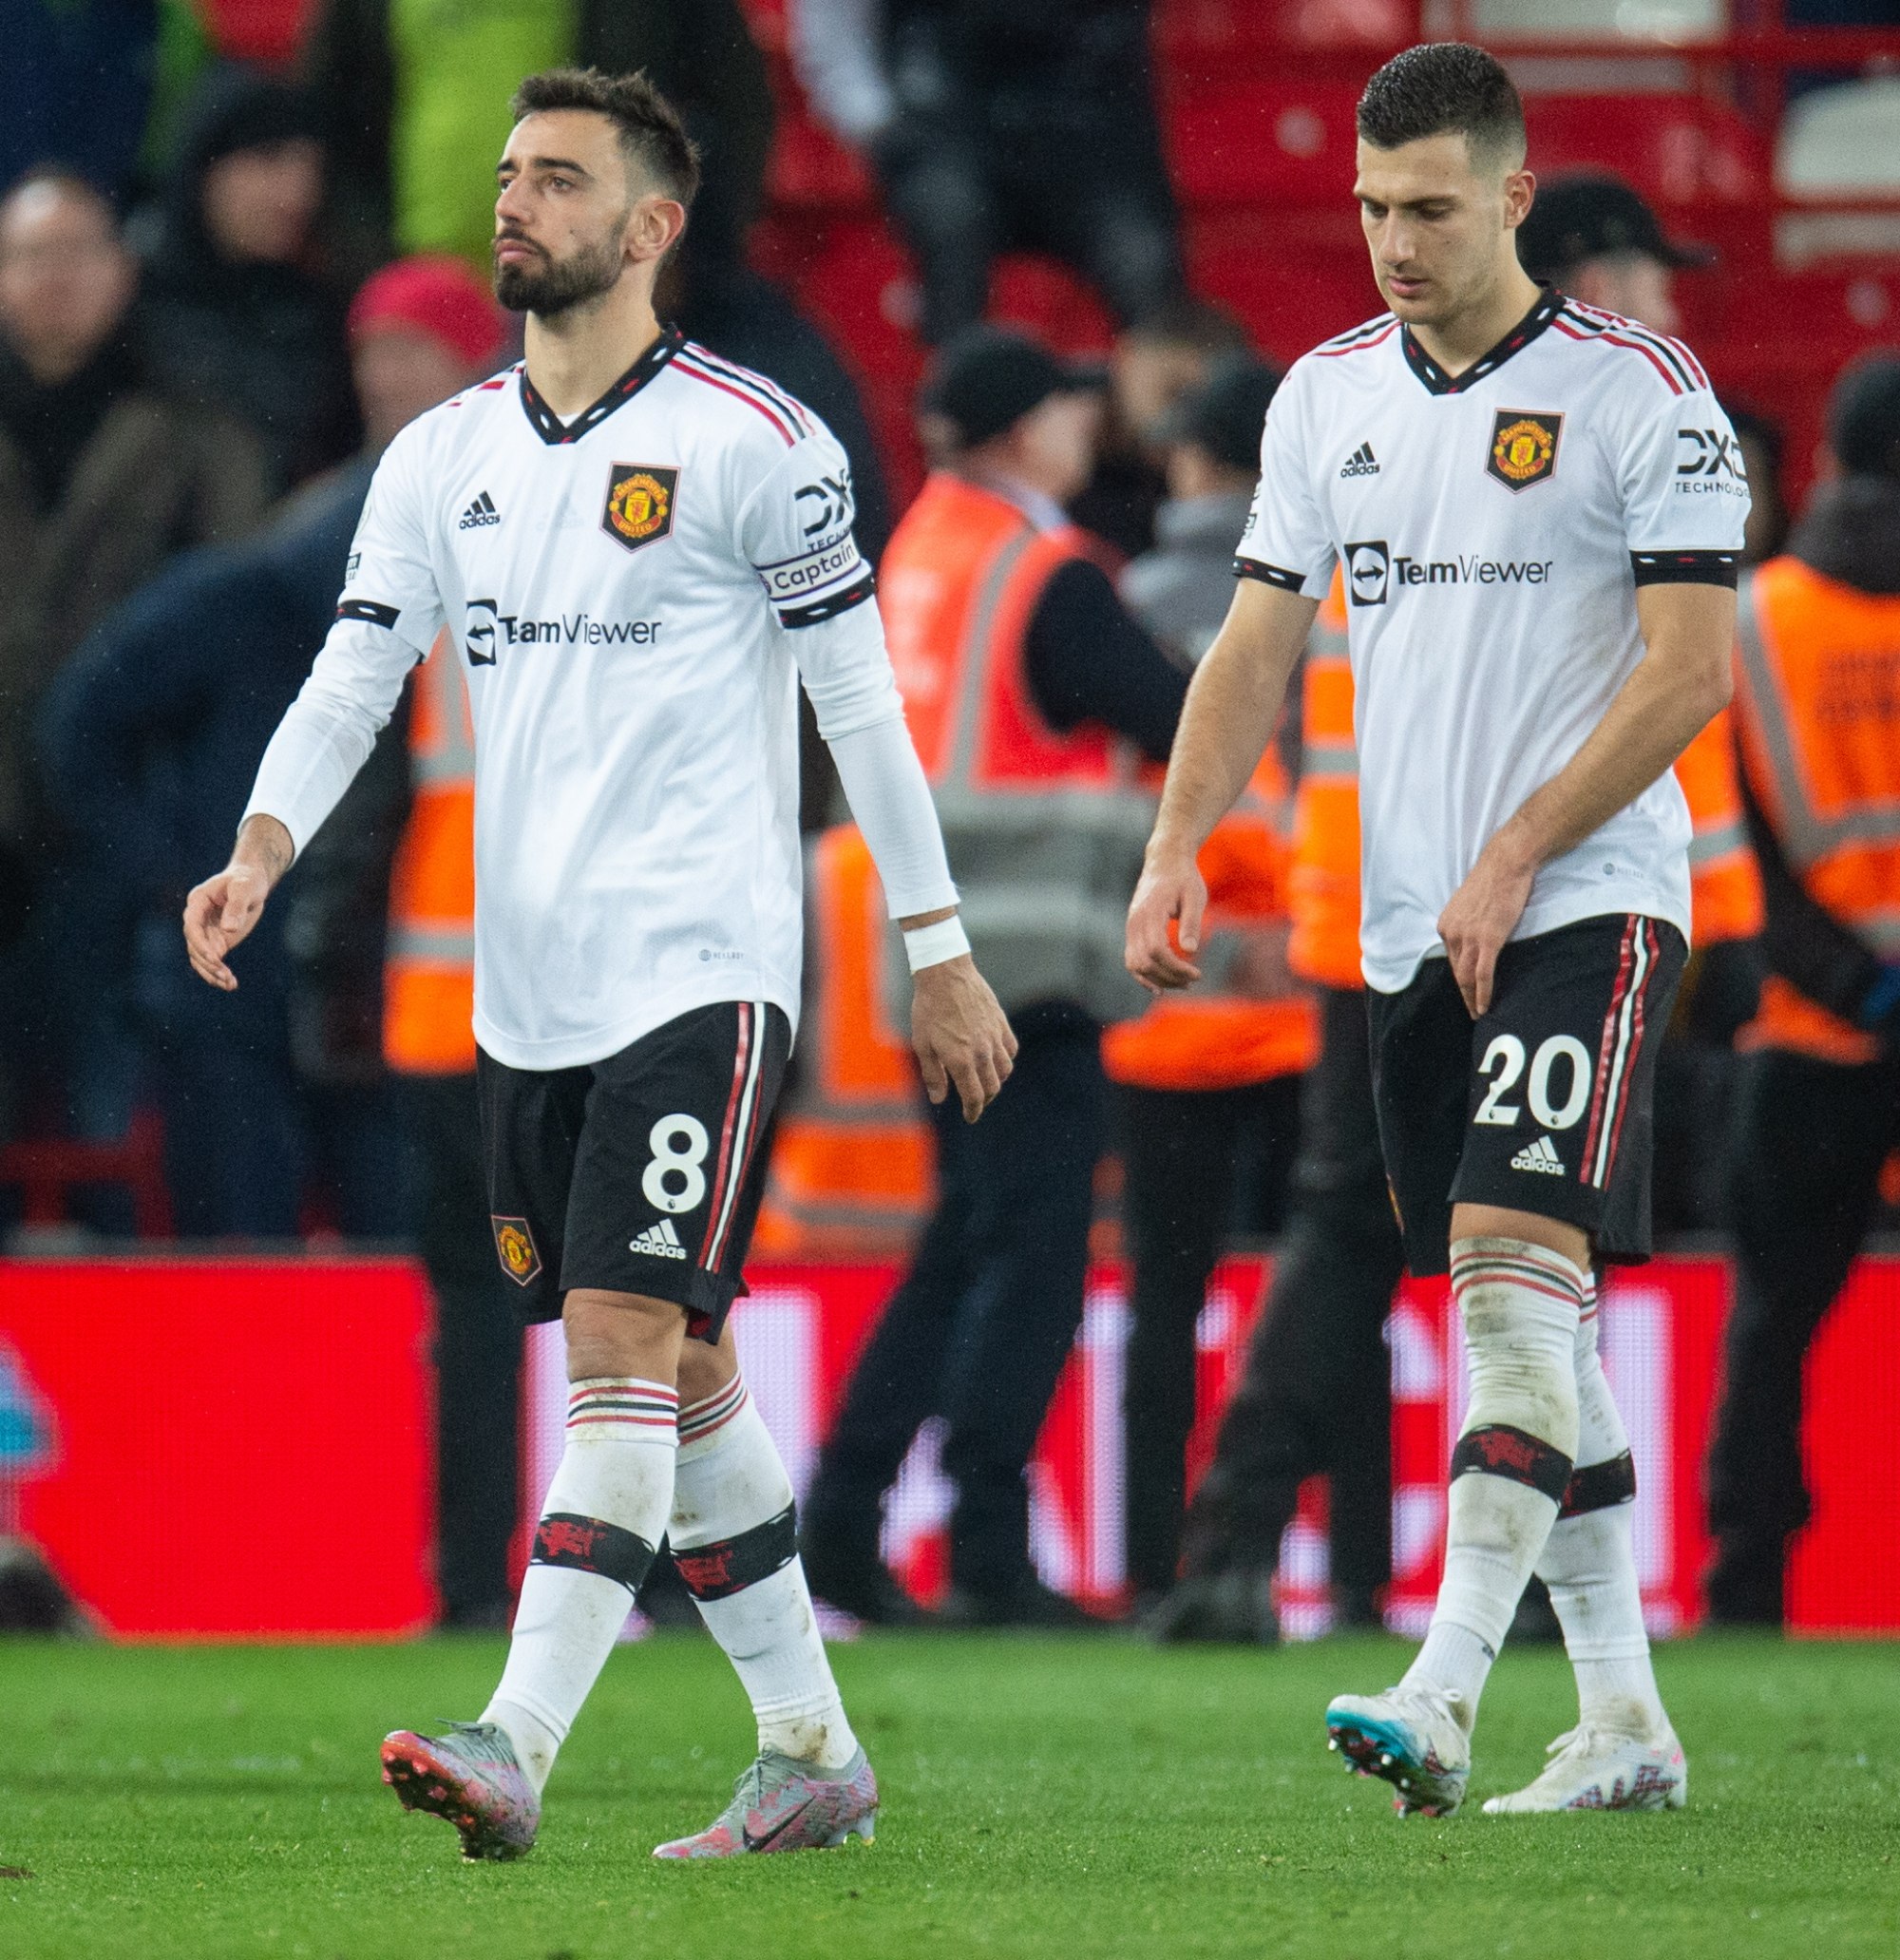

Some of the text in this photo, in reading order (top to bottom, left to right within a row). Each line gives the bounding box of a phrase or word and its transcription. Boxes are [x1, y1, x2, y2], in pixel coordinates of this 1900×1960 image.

[1340, 462, 1380, 478] adidas
[459, 514, 501, 529] adidas
[618, 522, 653, 533] UNITED
[774, 544, 855, 590] Captain
[1473, 1034, 1591, 1130] 20
[642, 1113, 709, 1213] 8
[1510, 1155, 1566, 1176] adidas
[629, 1239, 687, 1260] adidas
